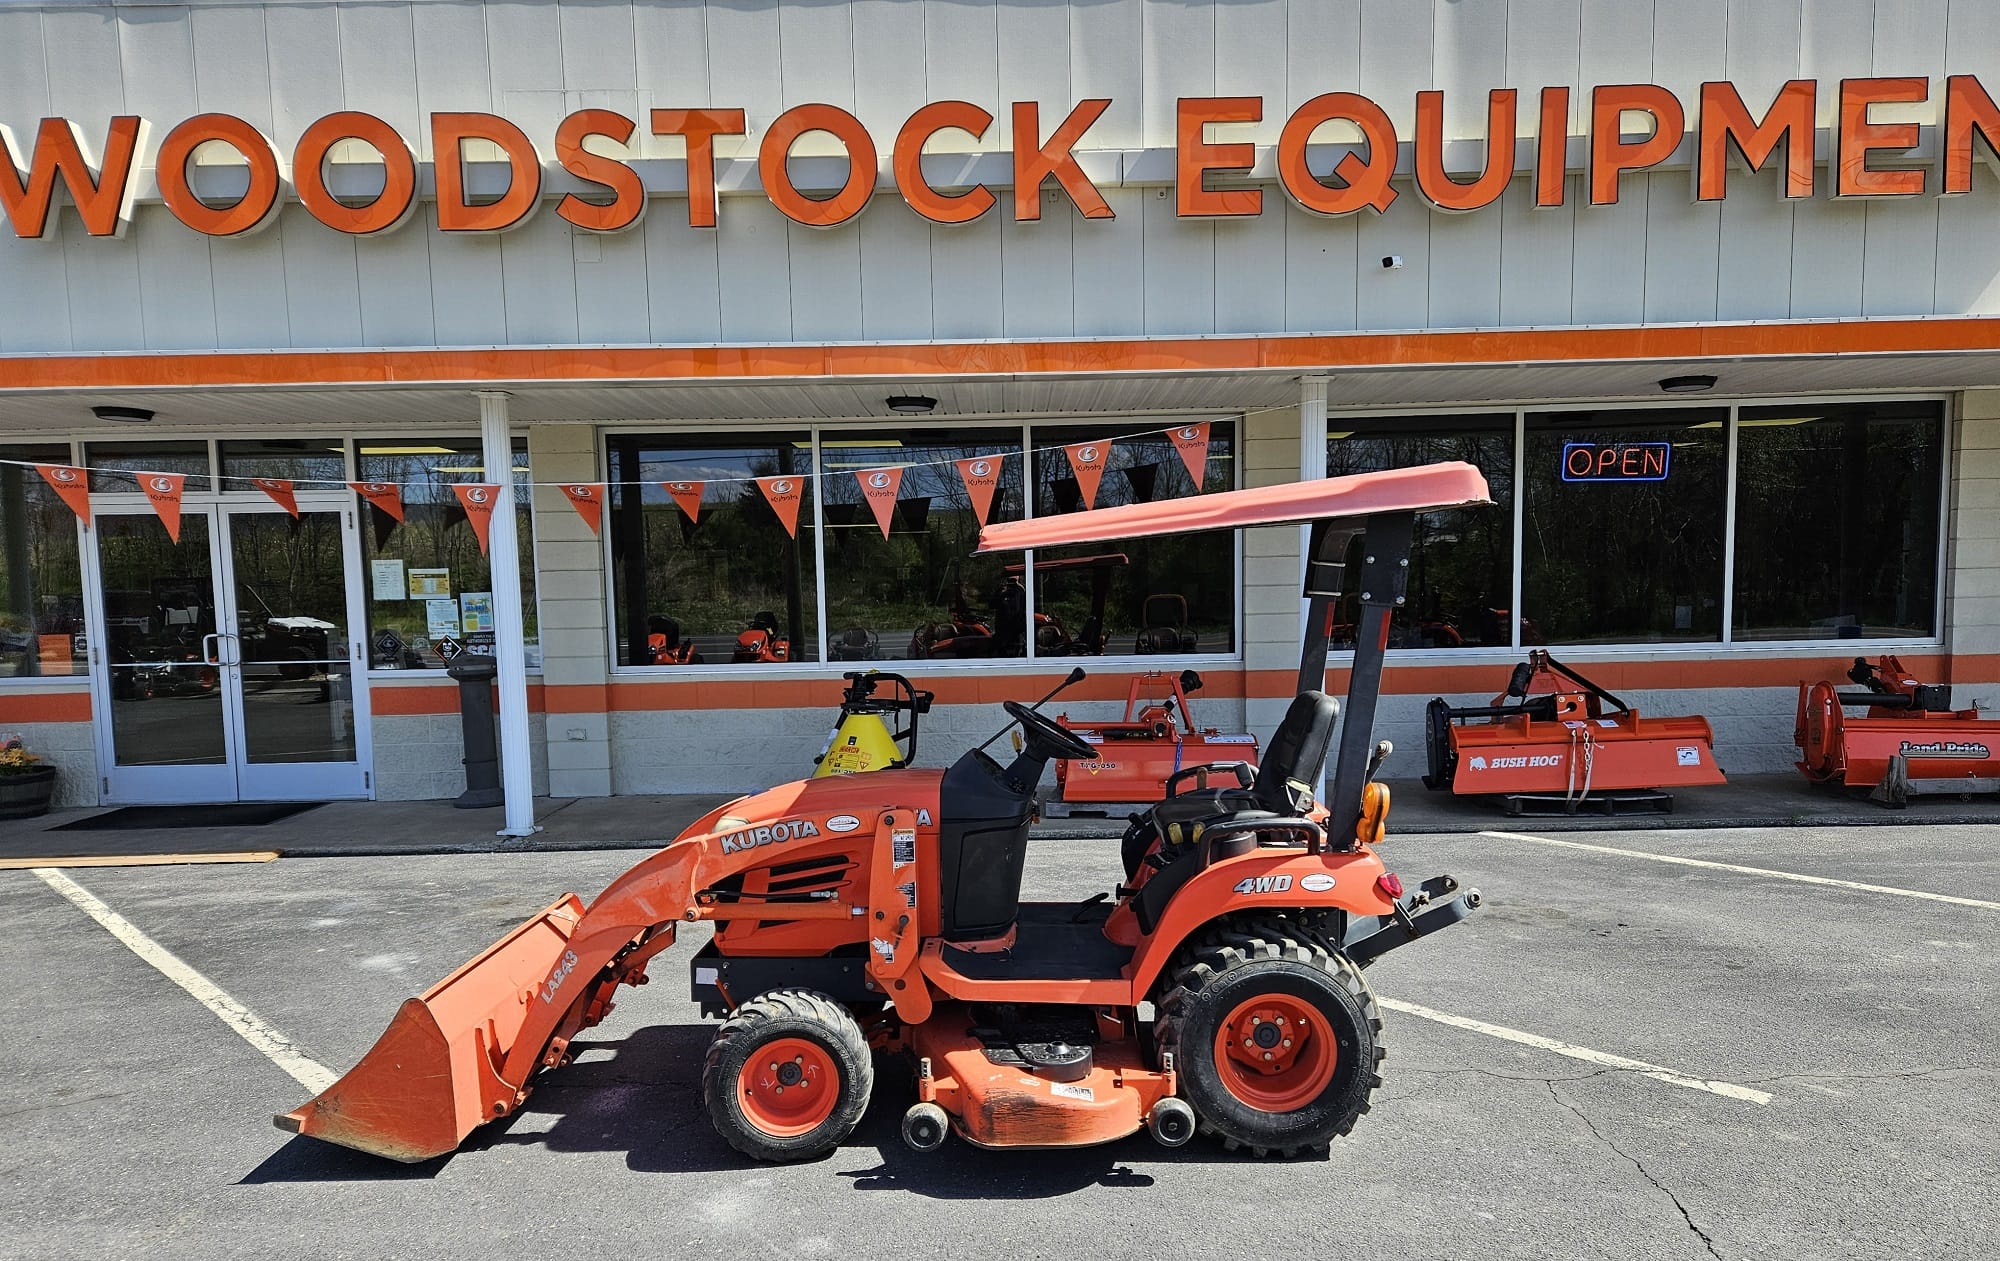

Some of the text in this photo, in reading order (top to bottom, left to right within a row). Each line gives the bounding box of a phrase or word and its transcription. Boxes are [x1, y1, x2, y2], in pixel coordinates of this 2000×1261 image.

[0, 98, 1117, 238] WOODSTOCK
[1178, 440, 1206, 450] Kubota
[1076, 463, 1102, 472] Kubota
[1567, 448, 1664, 476] OPEN
[967, 478, 996, 487] Kubota
[770, 494, 799, 503] Kubota
[867, 490, 896, 498] Kubota
[1901, 742, 1988, 753] Land Pride
[1490, 756, 1527, 769] BUSH
[720, 820, 819, 855] KUBOTA
[1233, 874, 1293, 895] 4WD
[541, 949, 579, 1005] LA243
